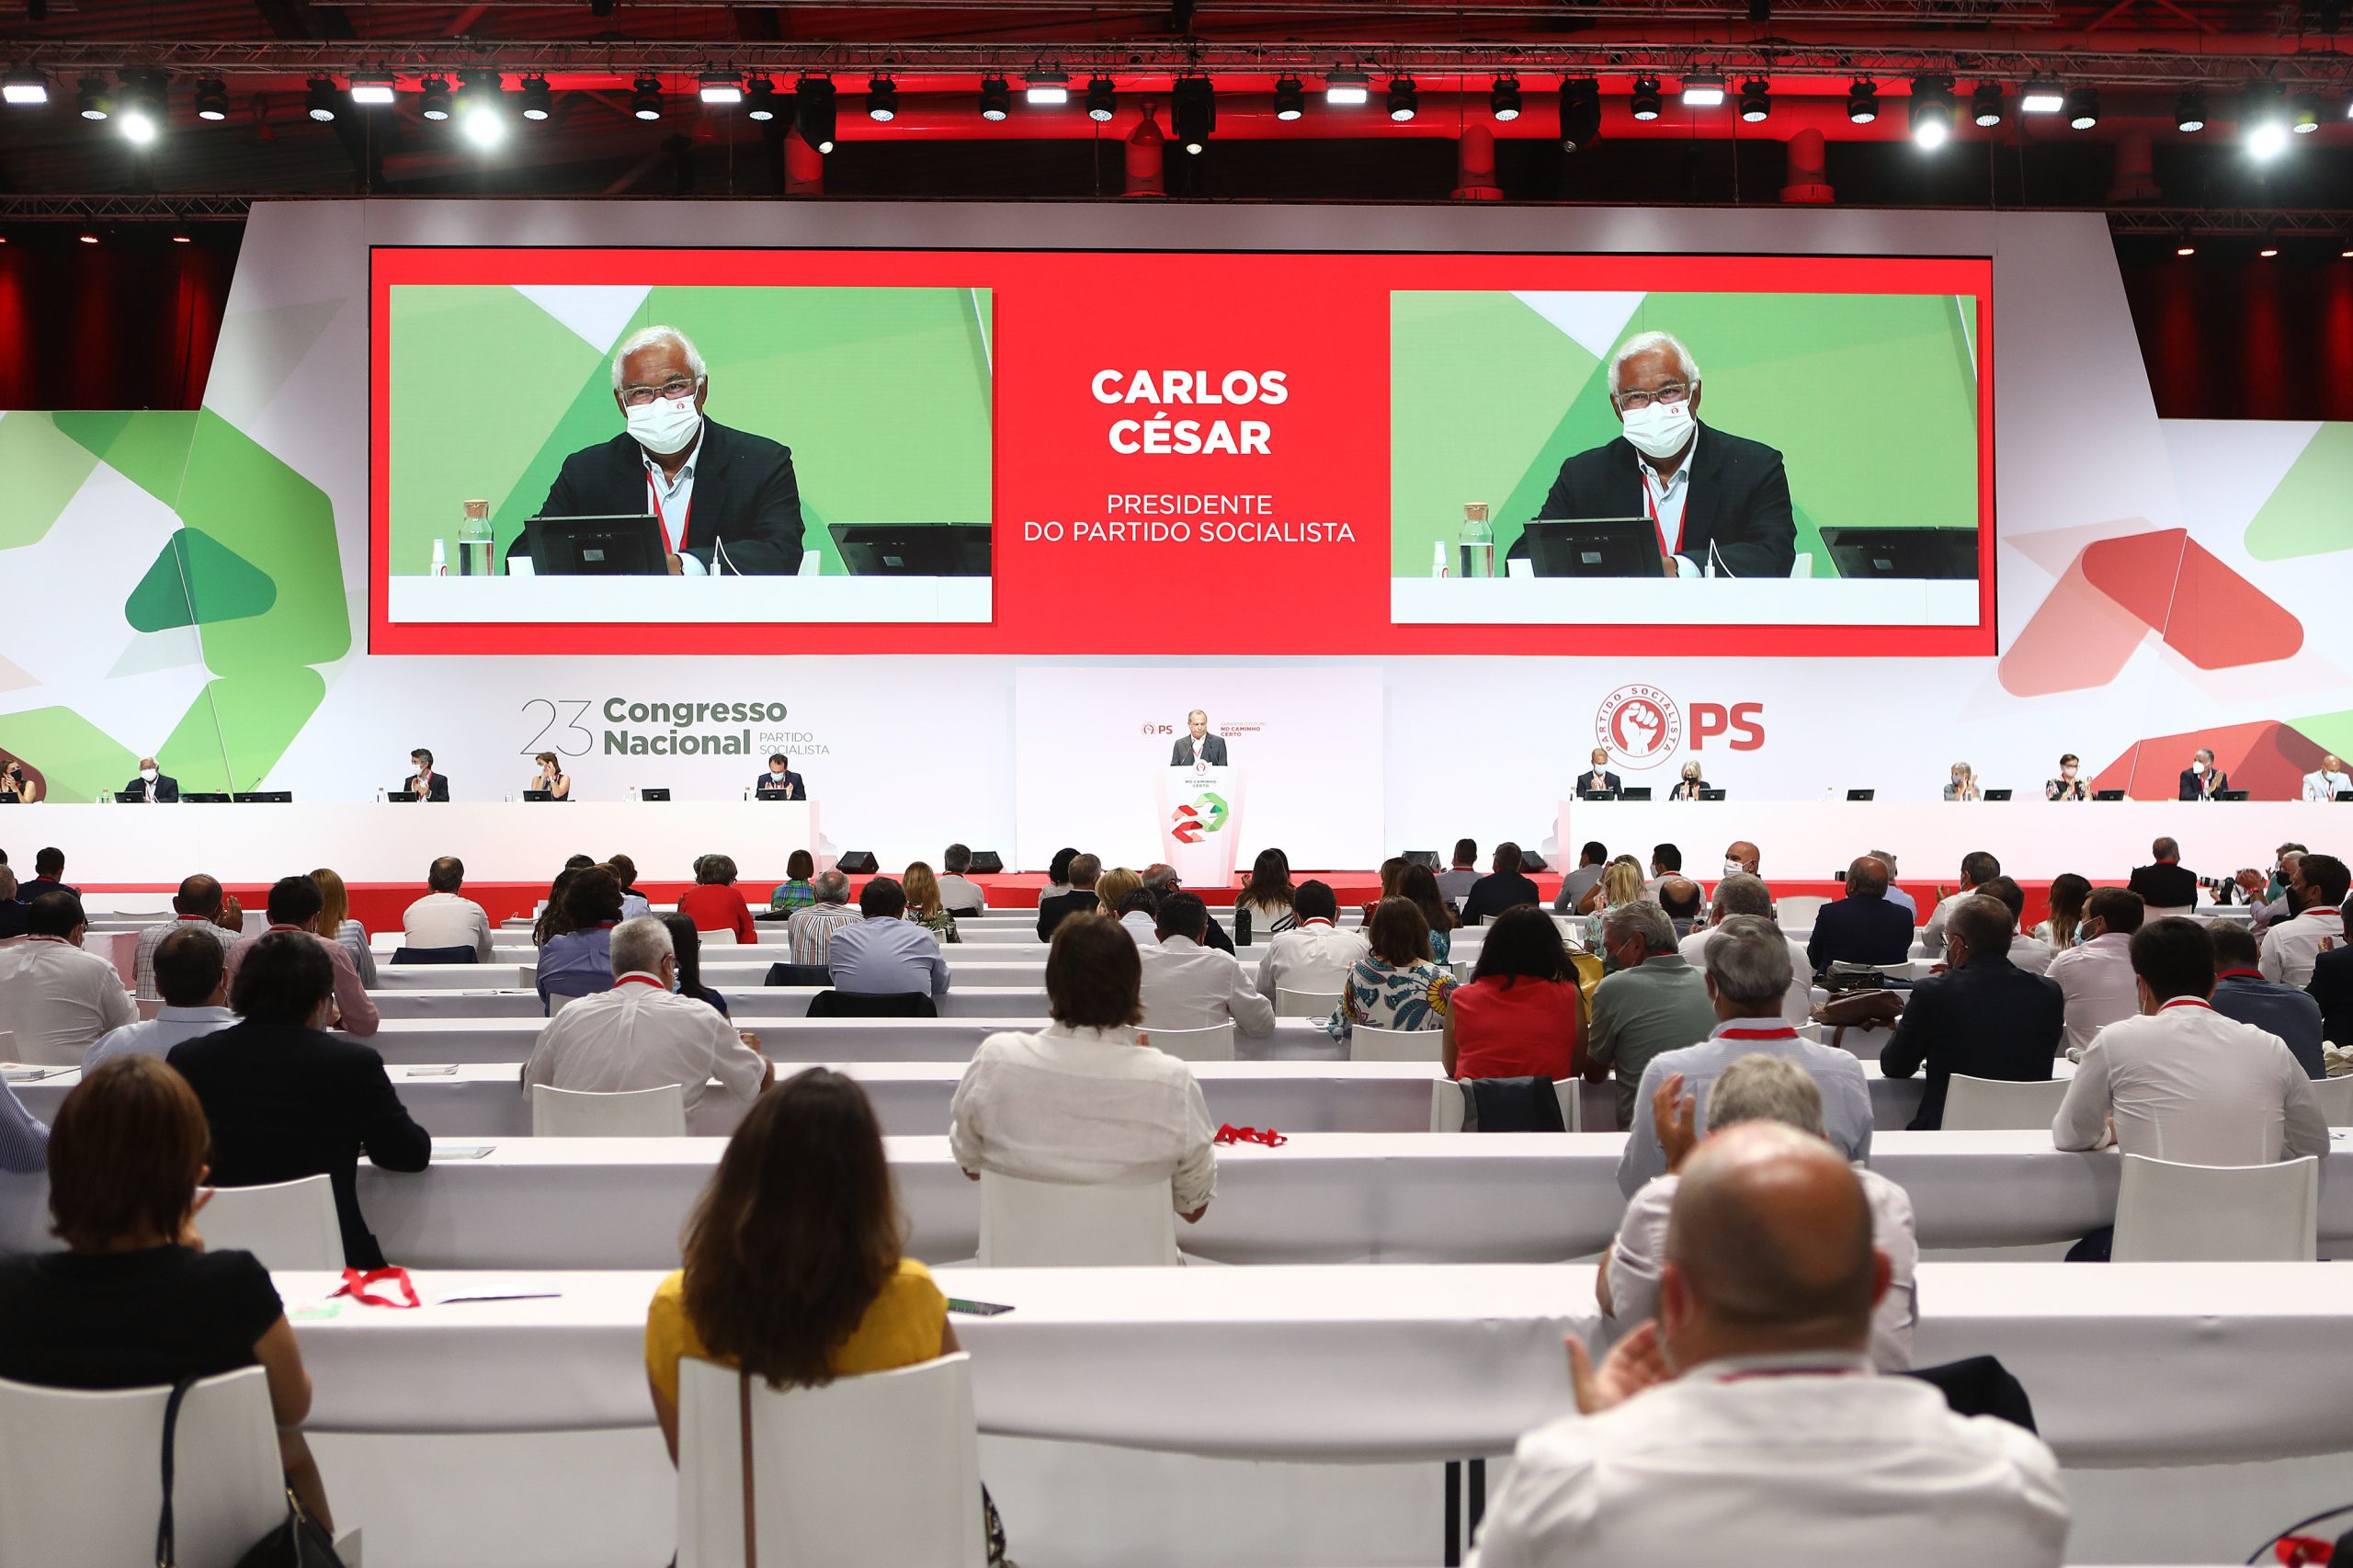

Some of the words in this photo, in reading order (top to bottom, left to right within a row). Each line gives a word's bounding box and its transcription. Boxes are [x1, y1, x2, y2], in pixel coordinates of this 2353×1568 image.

[1091, 369, 1289, 404] CARLOS
[1108, 411, 1272, 454] CÉSAR
[1107, 494, 1273, 515] PRESIDENTE
[1024, 521, 1064, 542] DO
[1073, 521, 1191, 542] PARTIDO
[1199, 521, 1356, 542] SOCIALISTA
[603, 697, 788, 728] Congresso
[1599, 694, 1621, 752] PARTIDO
[1631, 687, 1677, 752] SOCIALISTA
[1689, 702, 1766, 751] PS
[519, 699, 594, 756] 23
[759, 732, 813, 743] PARTIDO
[1158, 725, 1173, 734] PS
[604, 729, 751, 756] Nacional
[759, 744, 830, 756] SOCIALISTA
